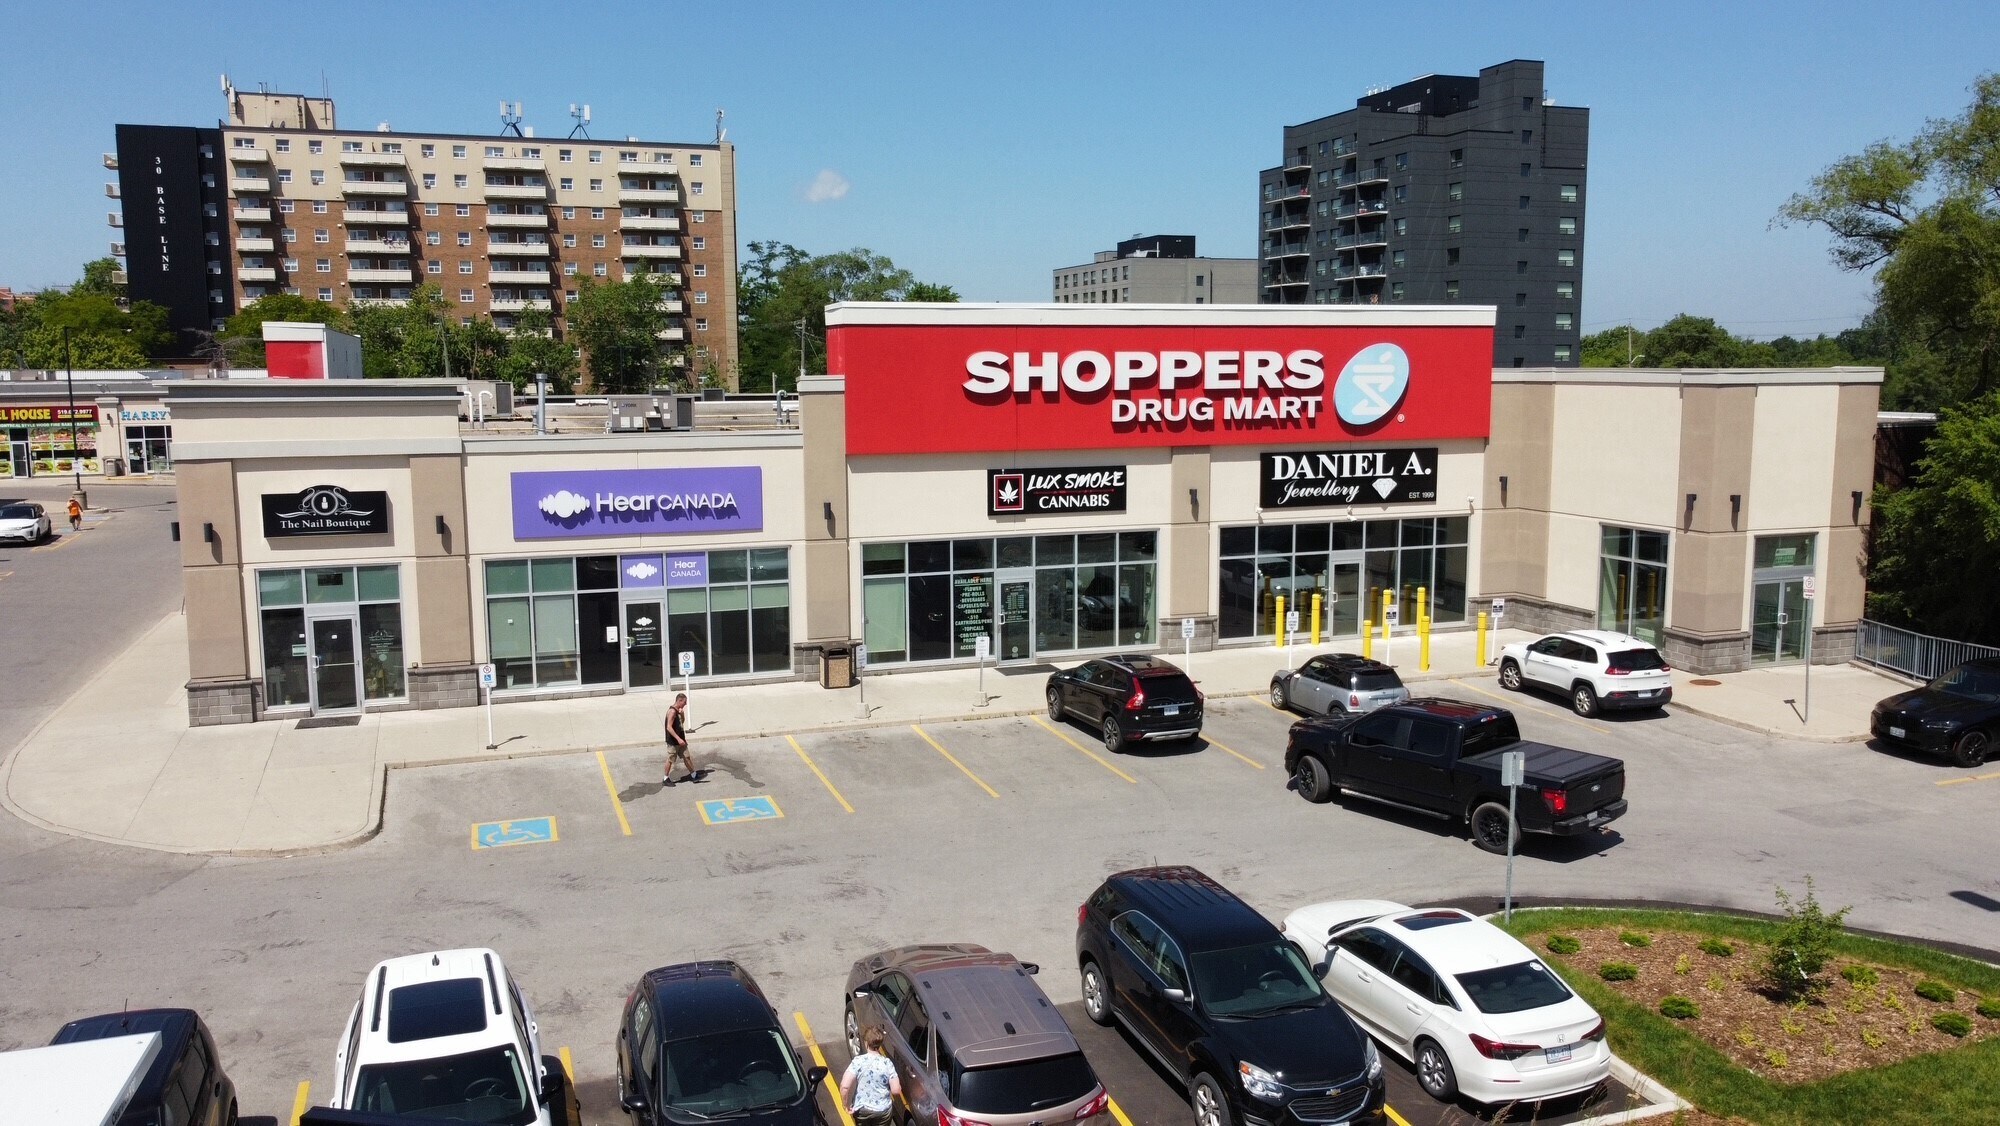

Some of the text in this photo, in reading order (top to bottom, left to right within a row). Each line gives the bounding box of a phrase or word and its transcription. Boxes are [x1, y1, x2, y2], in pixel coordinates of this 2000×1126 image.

[155, 156, 170, 272] 30 BASE LINE
[961, 349, 1325, 394] SHOPPERS
[10, 408, 51, 421] HOUSE
[1111, 396, 1323, 423] DRUG MART
[1271, 451, 1432, 480] DANIEL A.
[1026, 470, 1125, 492] LUX SMOKE
[595, 492, 737, 513] Hear CANADA
[1038, 493, 1110, 509] CANNABIS
[1277, 479, 1360, 505] Jewellery
[279, 518, 371, 529] The Nail Boutique
[670, 569, 702, 578] CANADA
[674, 560, 697, 569] Hear
